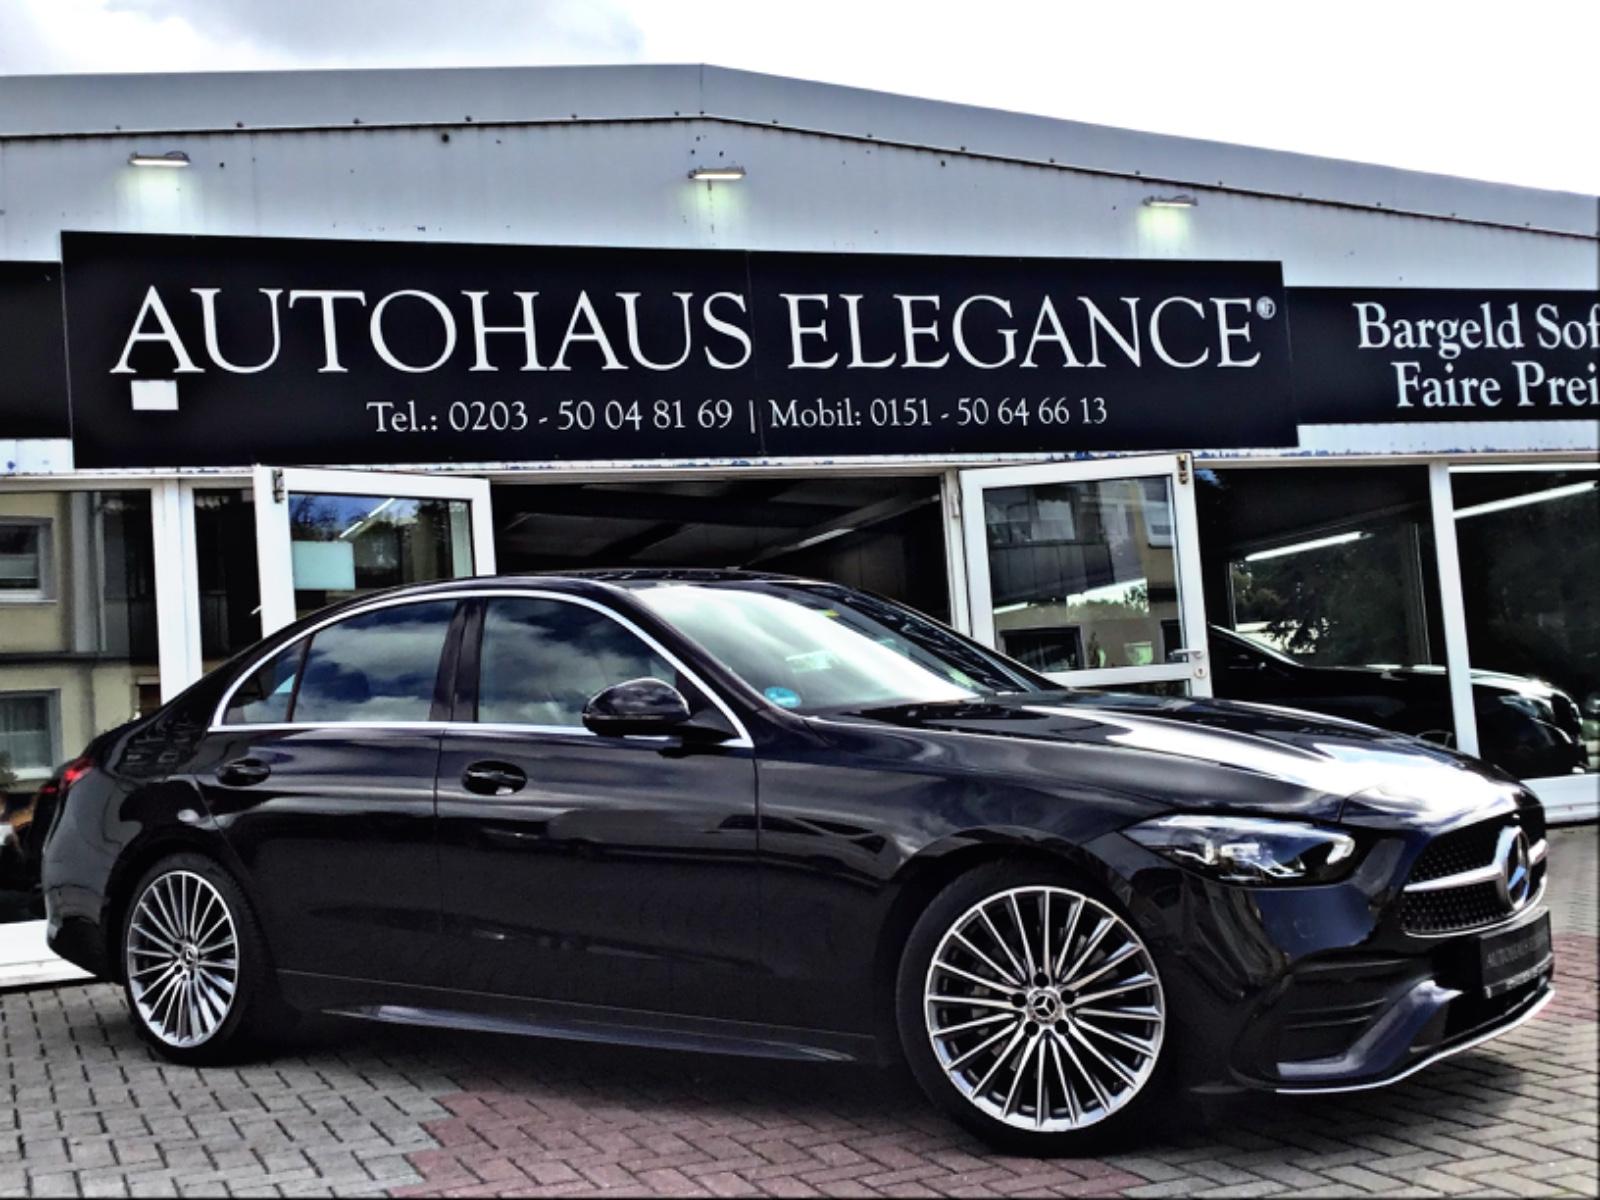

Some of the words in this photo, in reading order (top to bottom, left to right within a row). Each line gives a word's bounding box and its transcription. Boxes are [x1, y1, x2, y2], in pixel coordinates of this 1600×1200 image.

[110, 285, 752, 374] AUTOHAUS
[1352, 302, 1525, 360] Bargeld
[1390, 361, 1501, 408] Faire
[1511, 360, 1600, 407] Prei
[366, 401, 438, 432] Tel.:
[448, 401, 528, 431] 0203
[558, 400, 595, 430] 50
[605, 400, 643, 431] 04
[653, 399, 685, 429] 81
[697, 399, 733, 429] 69
[768, 397, 862, 427] Mobil:
[870, 398, 931, 426] 0151
[958, 397, 989, 425] 50
[997, 397, 1030, 426] 64
[1038, 397, 1070, 424] 66
[1080, 397, 1107, 424] 13
